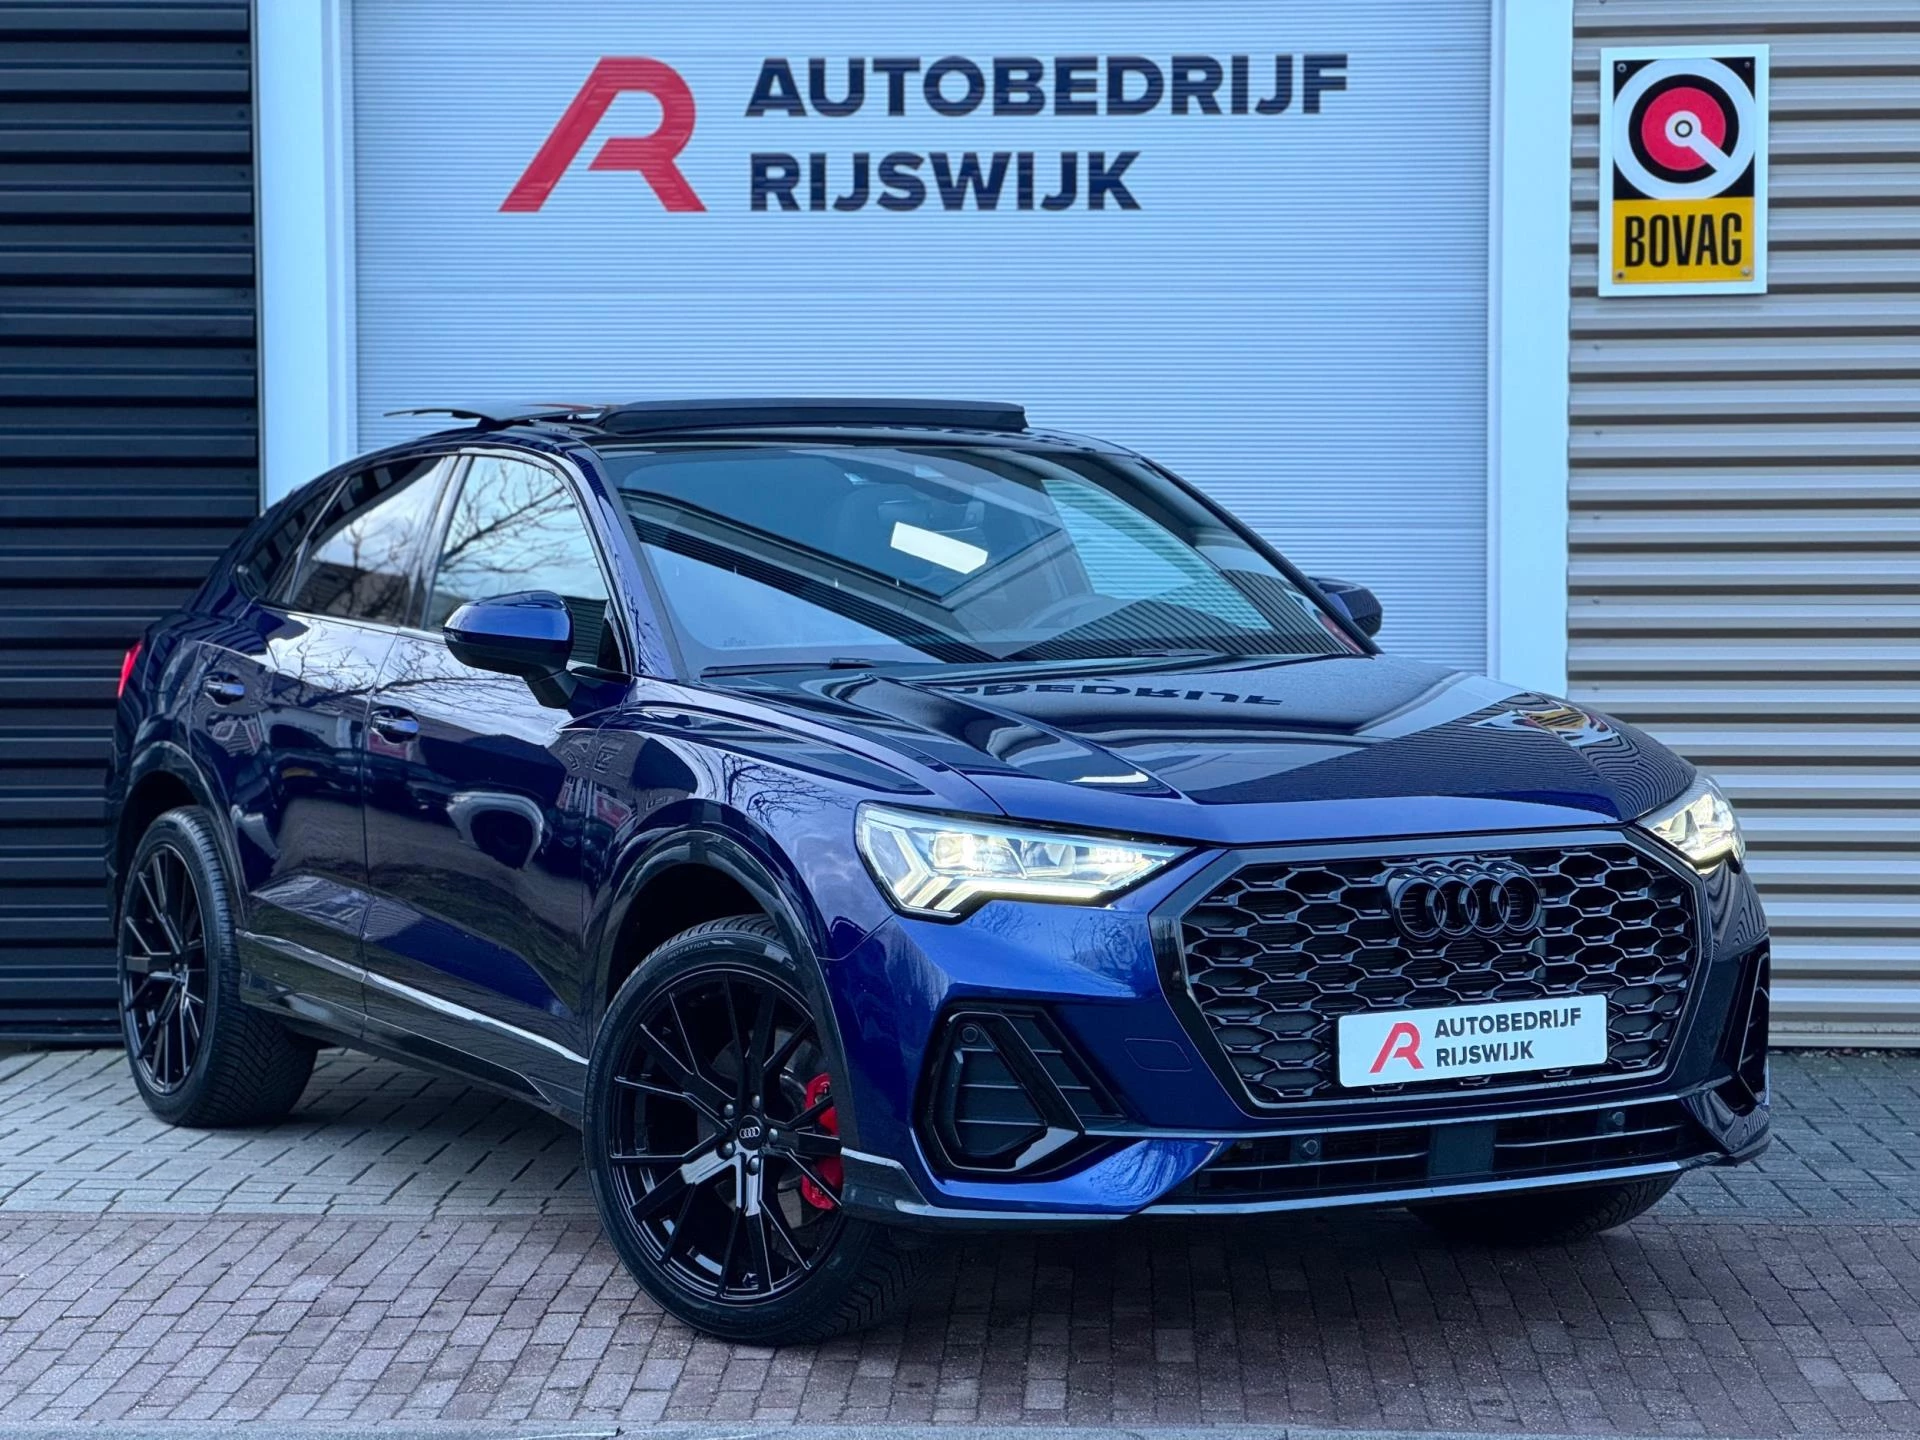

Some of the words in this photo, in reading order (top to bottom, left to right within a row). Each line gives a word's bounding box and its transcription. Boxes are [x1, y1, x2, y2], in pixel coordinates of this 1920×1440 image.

[747, 54, 1348, 118] AUTOBEDRIJF
[751, 151, 1142, 213] RIJSWIJK
[1624, 212, 1743, 268] BOVAG
[1434, 1007, 1582, 1039] AUTOBEDRIJF
[1435, 1040, 1534, 1068] RIJSWIJK
